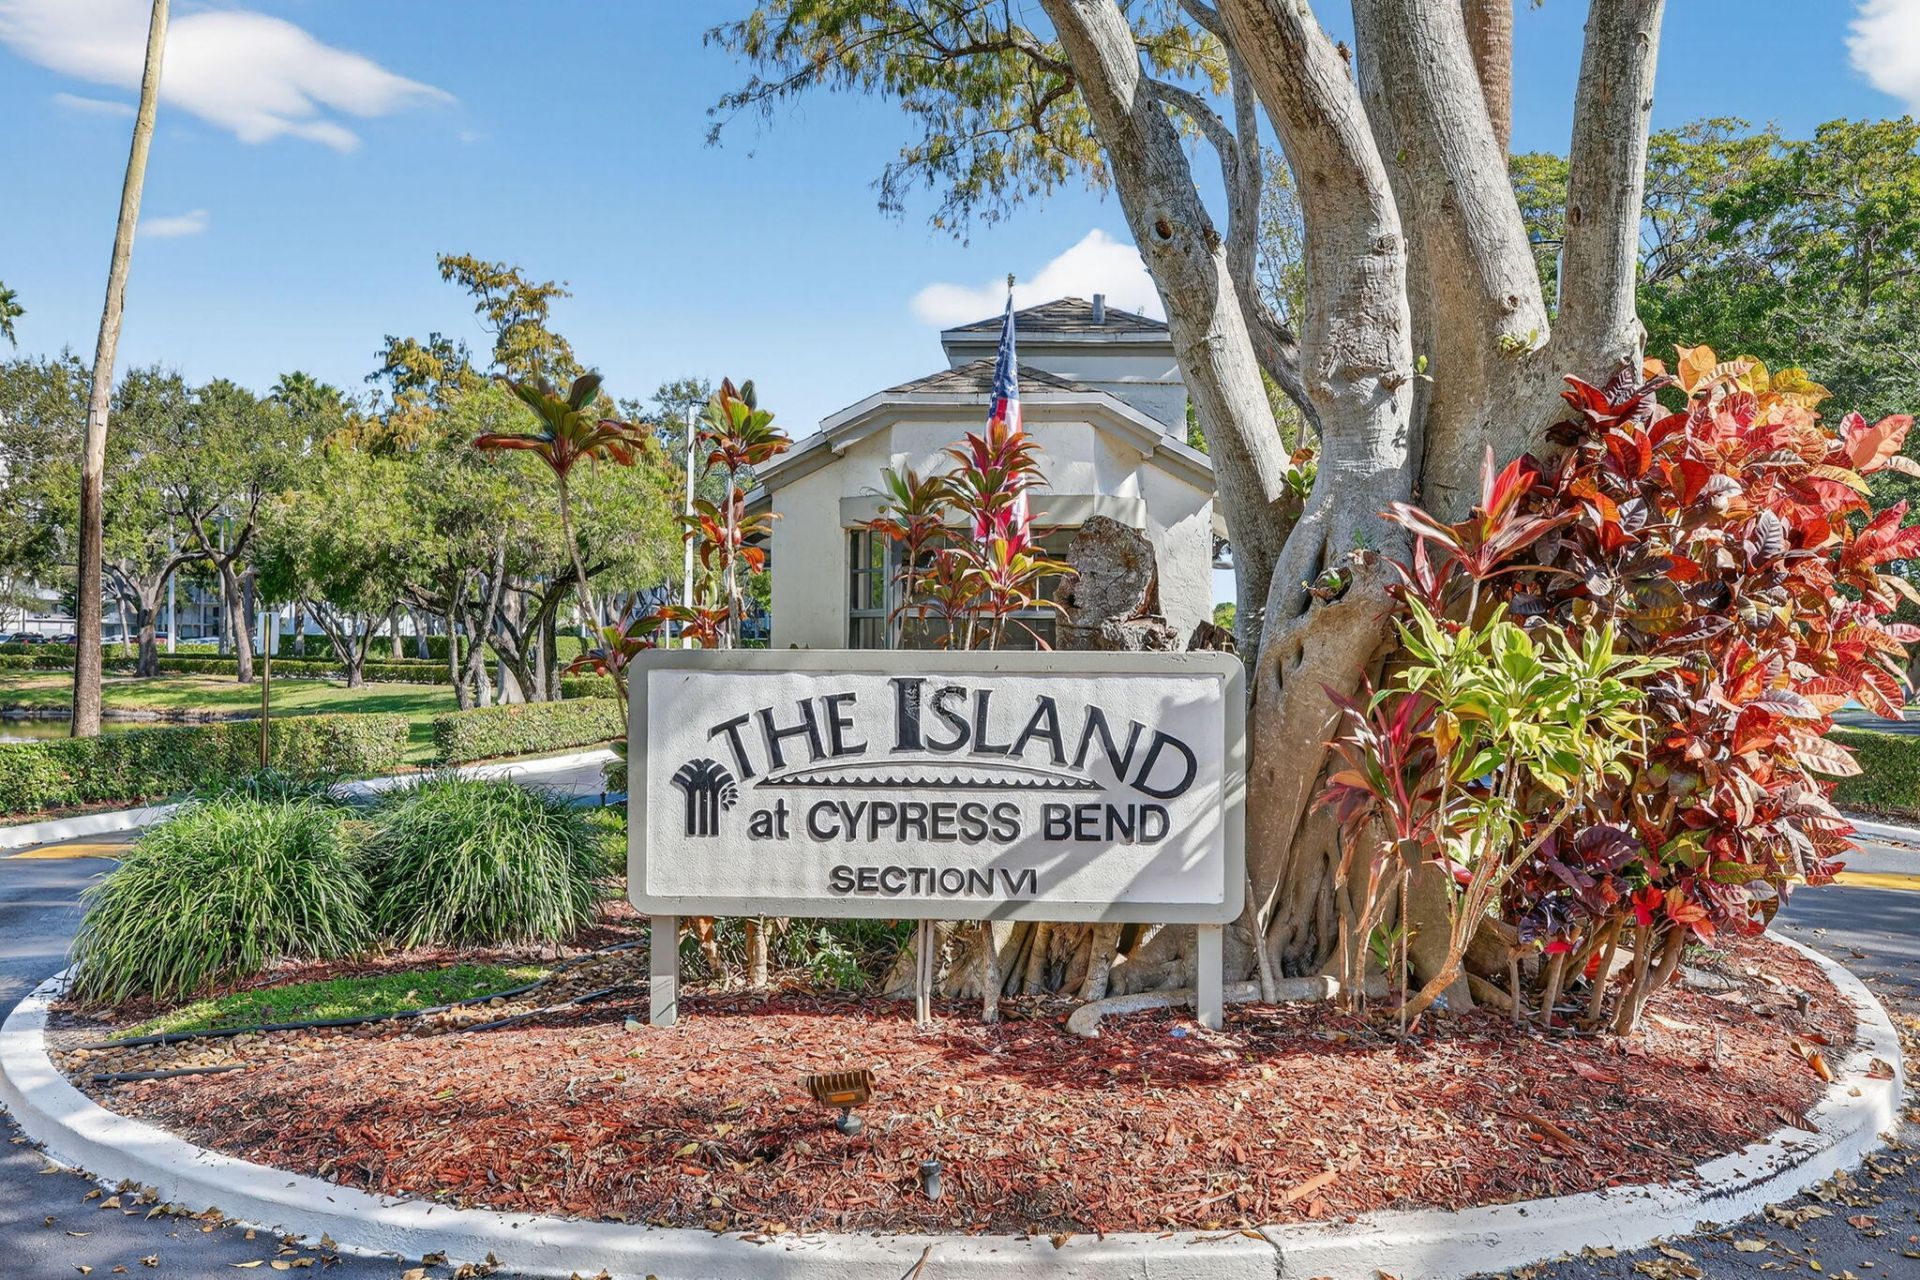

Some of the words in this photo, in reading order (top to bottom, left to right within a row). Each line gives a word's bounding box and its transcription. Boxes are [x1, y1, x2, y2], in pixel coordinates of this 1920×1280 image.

[708, 692, 868, 783] THE
[888, 677, 1198, 799] ISLAND
[747, 798, 789, 841] at
[806, 800, 1022, 843] CYPRESS
[1042, 803, 1171, 844] BEND
[830, 865, 994, 896] SECTION
[1001, 868, 1038, 896] VI
